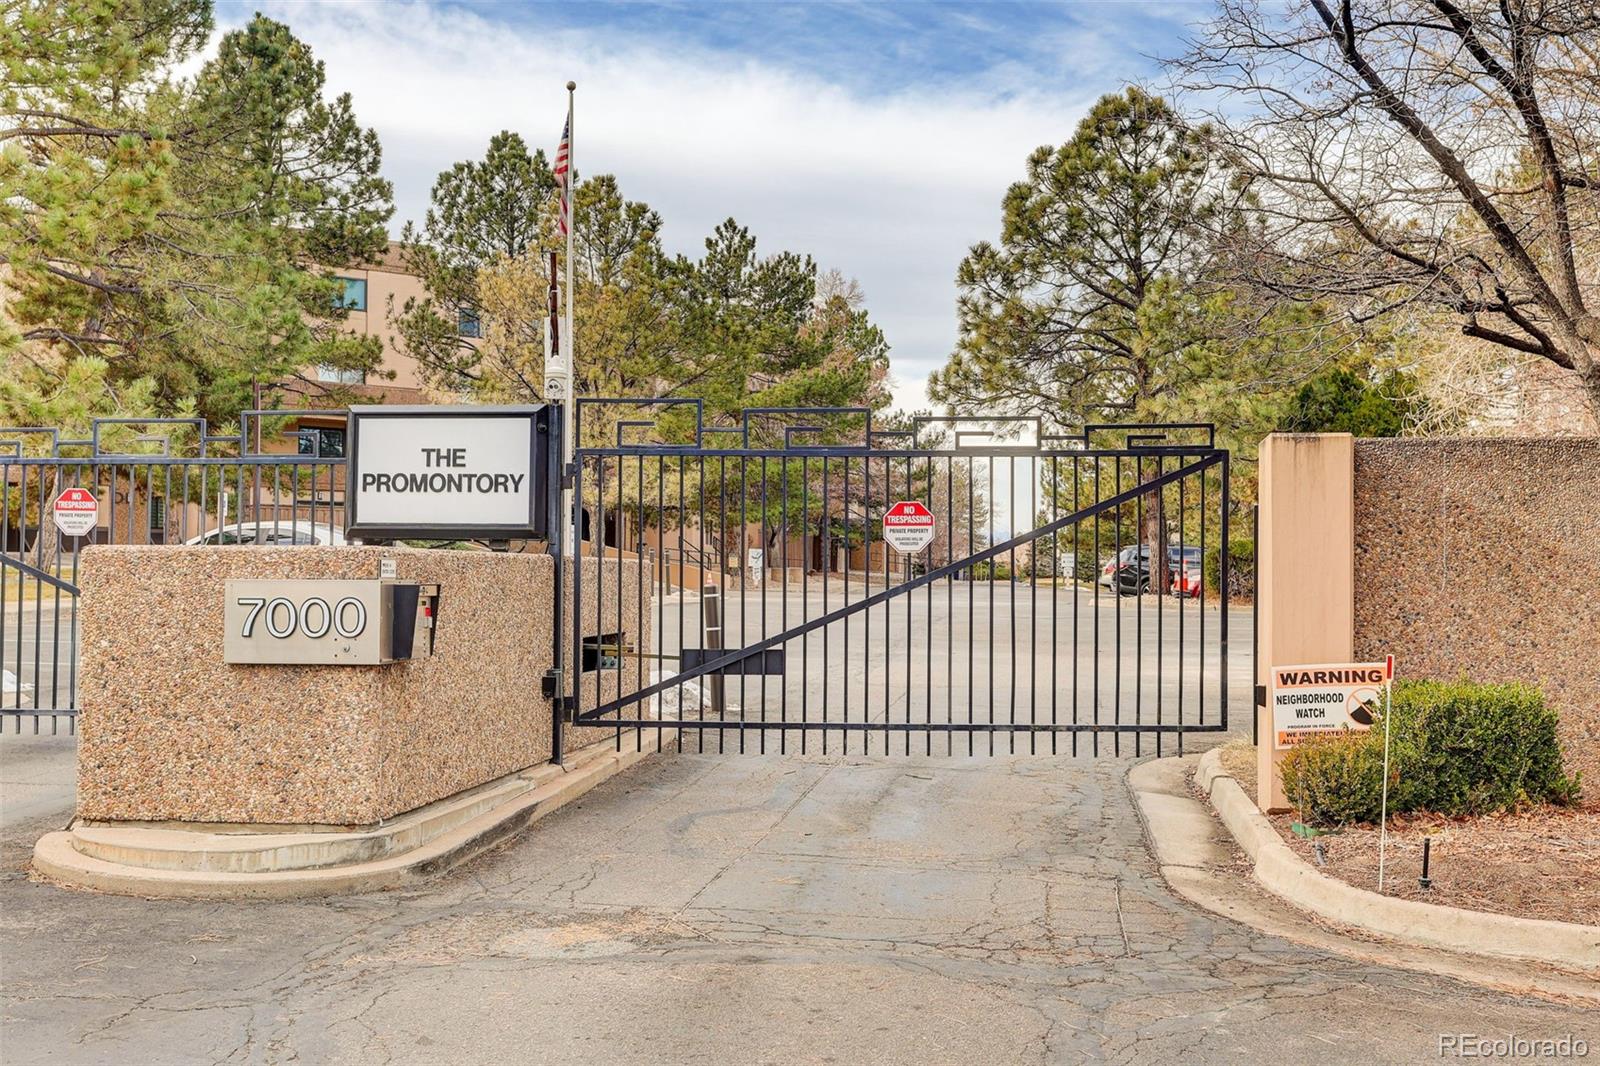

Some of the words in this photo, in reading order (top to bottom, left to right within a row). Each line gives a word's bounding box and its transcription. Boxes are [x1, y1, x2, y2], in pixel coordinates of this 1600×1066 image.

[421, 448, 466, 467] THE
[362, 473, 525, 493] PROMONTORY
[71, 492, 82, 500] NO
[904, 506, 915, 514] NO
[887, 515, 931, 523] TRESPASSING
[237, 596, 367, 639] 7000
[1280, 670, 1382, 686] WARNING
[1276, 693, 1344, 705] NEIGHBORHOOD
[1295, 708, 1326, 718] WATCH
